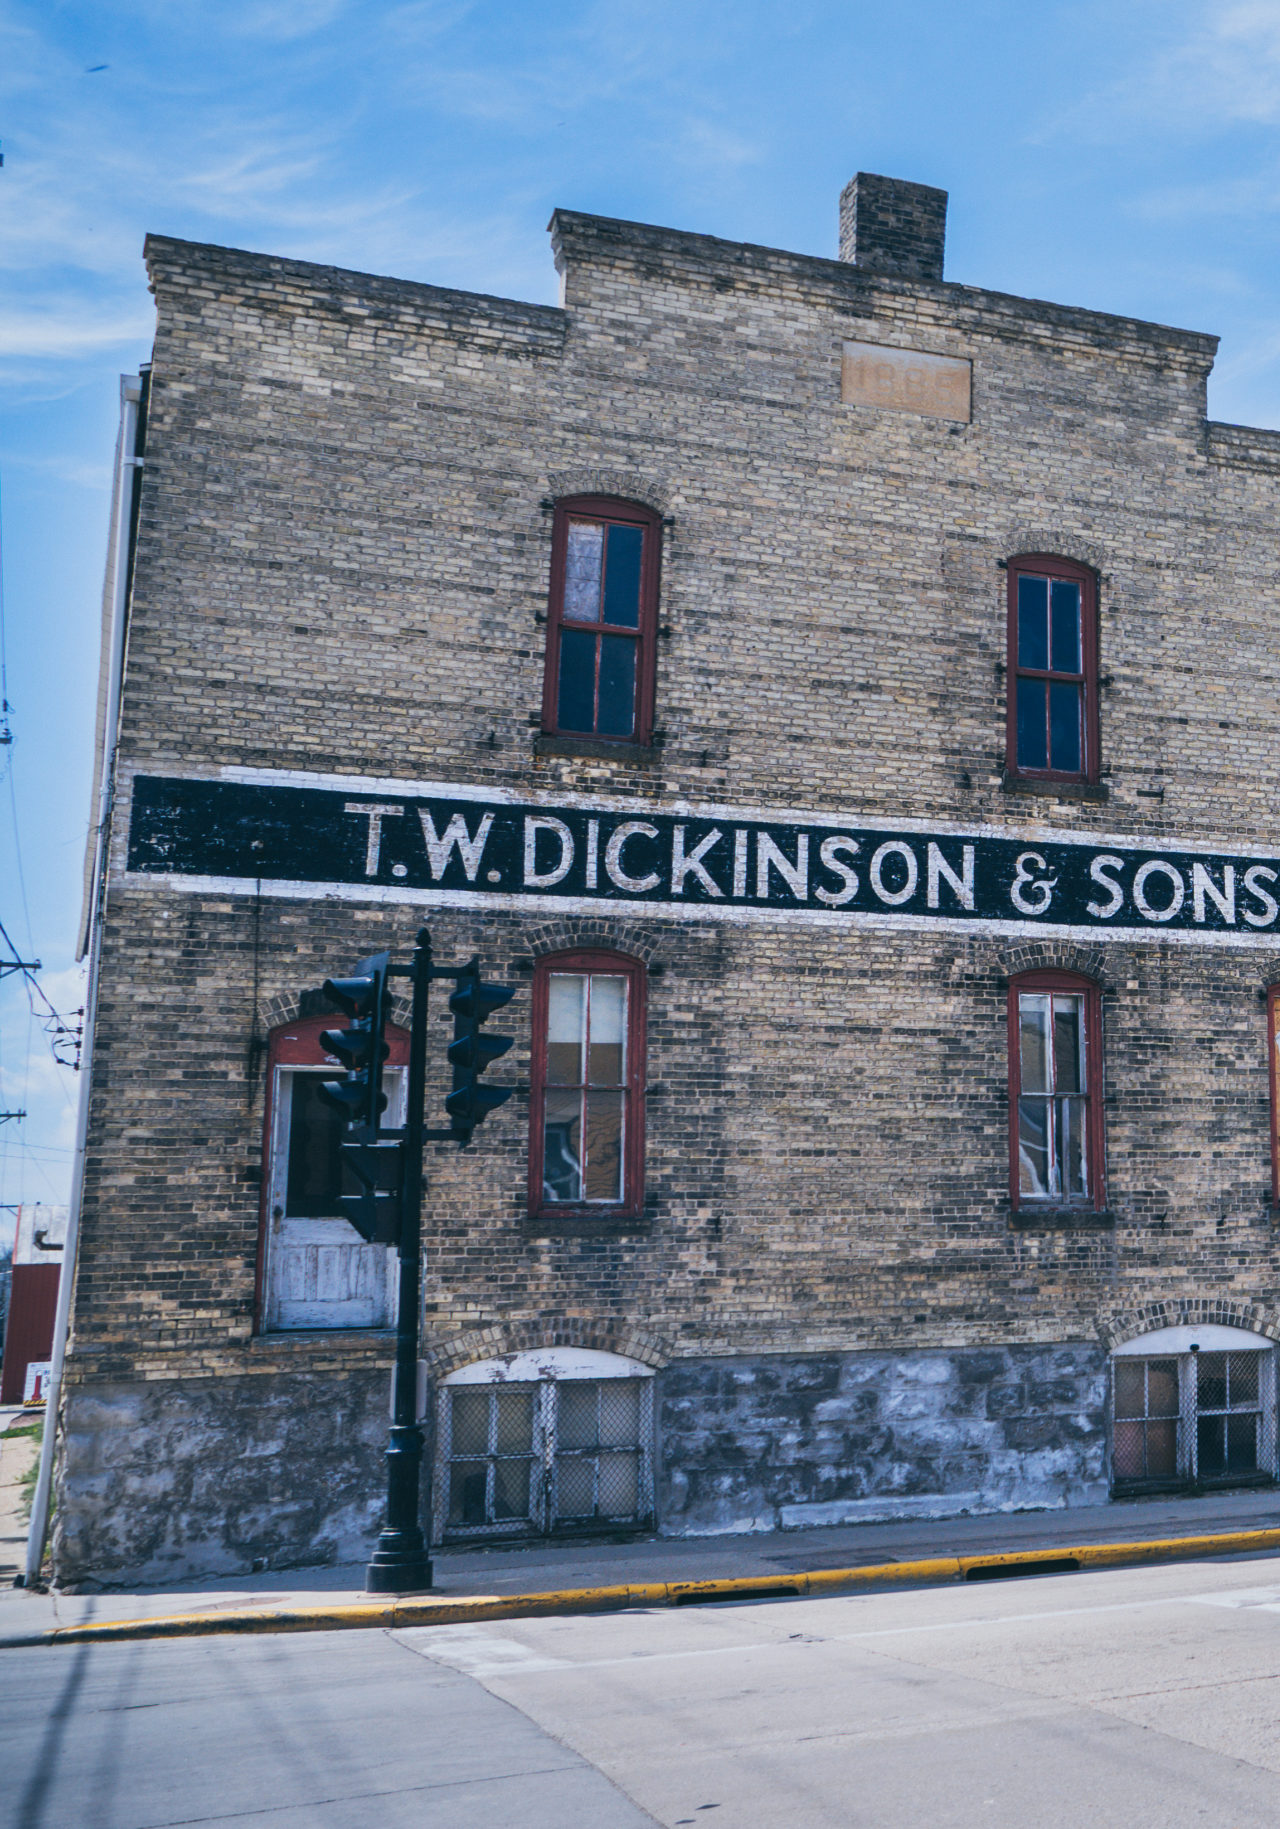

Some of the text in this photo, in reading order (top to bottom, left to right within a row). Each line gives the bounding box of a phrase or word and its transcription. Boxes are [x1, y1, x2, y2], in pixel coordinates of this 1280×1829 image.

[523, 814, 975, 912] DICKINSON
[1010, 851, 1059, 916] &
[1085, 854, 1279, 928] SONS
